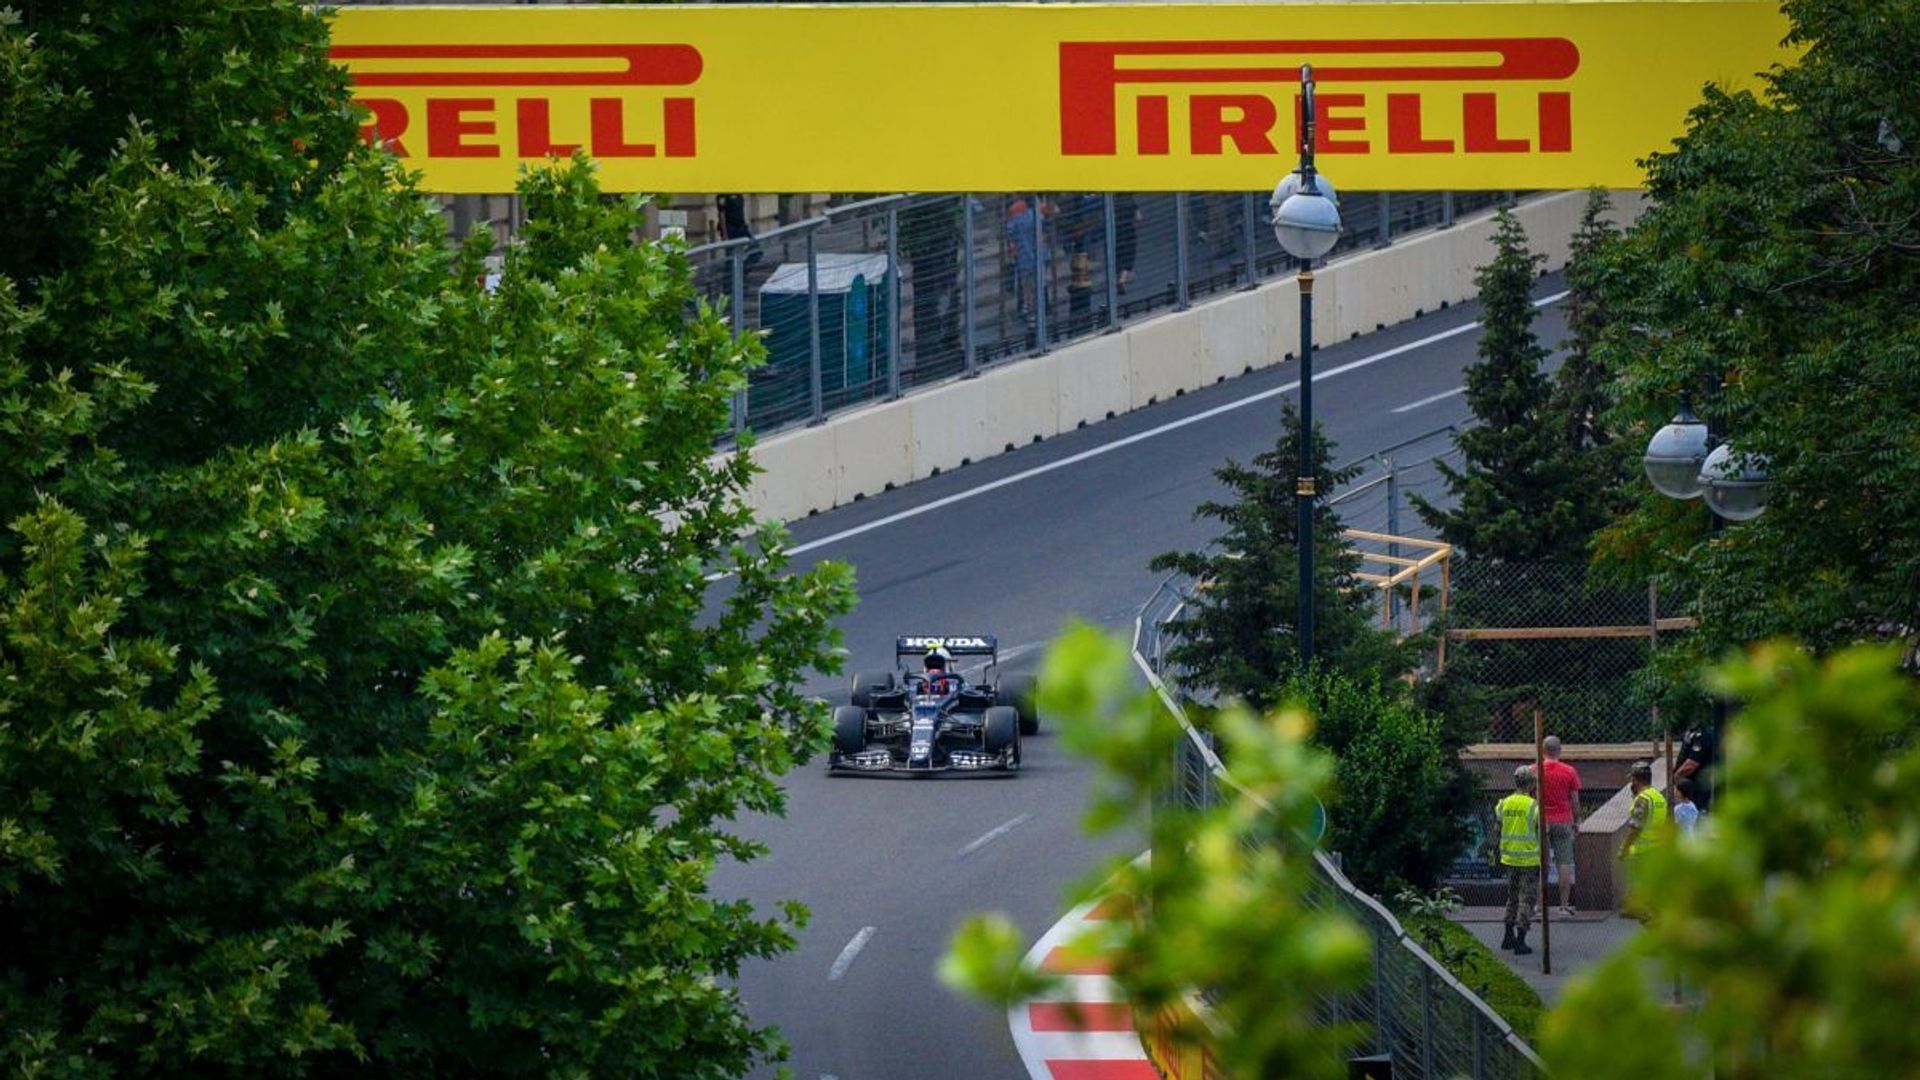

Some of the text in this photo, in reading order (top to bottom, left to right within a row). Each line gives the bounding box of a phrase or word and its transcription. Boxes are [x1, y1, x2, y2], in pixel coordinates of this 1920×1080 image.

[329, 44, 703, 157] RELLI
[1060, 38, 1580, 155] PIRELLI
[906, 637, 987, 647] HONDA
